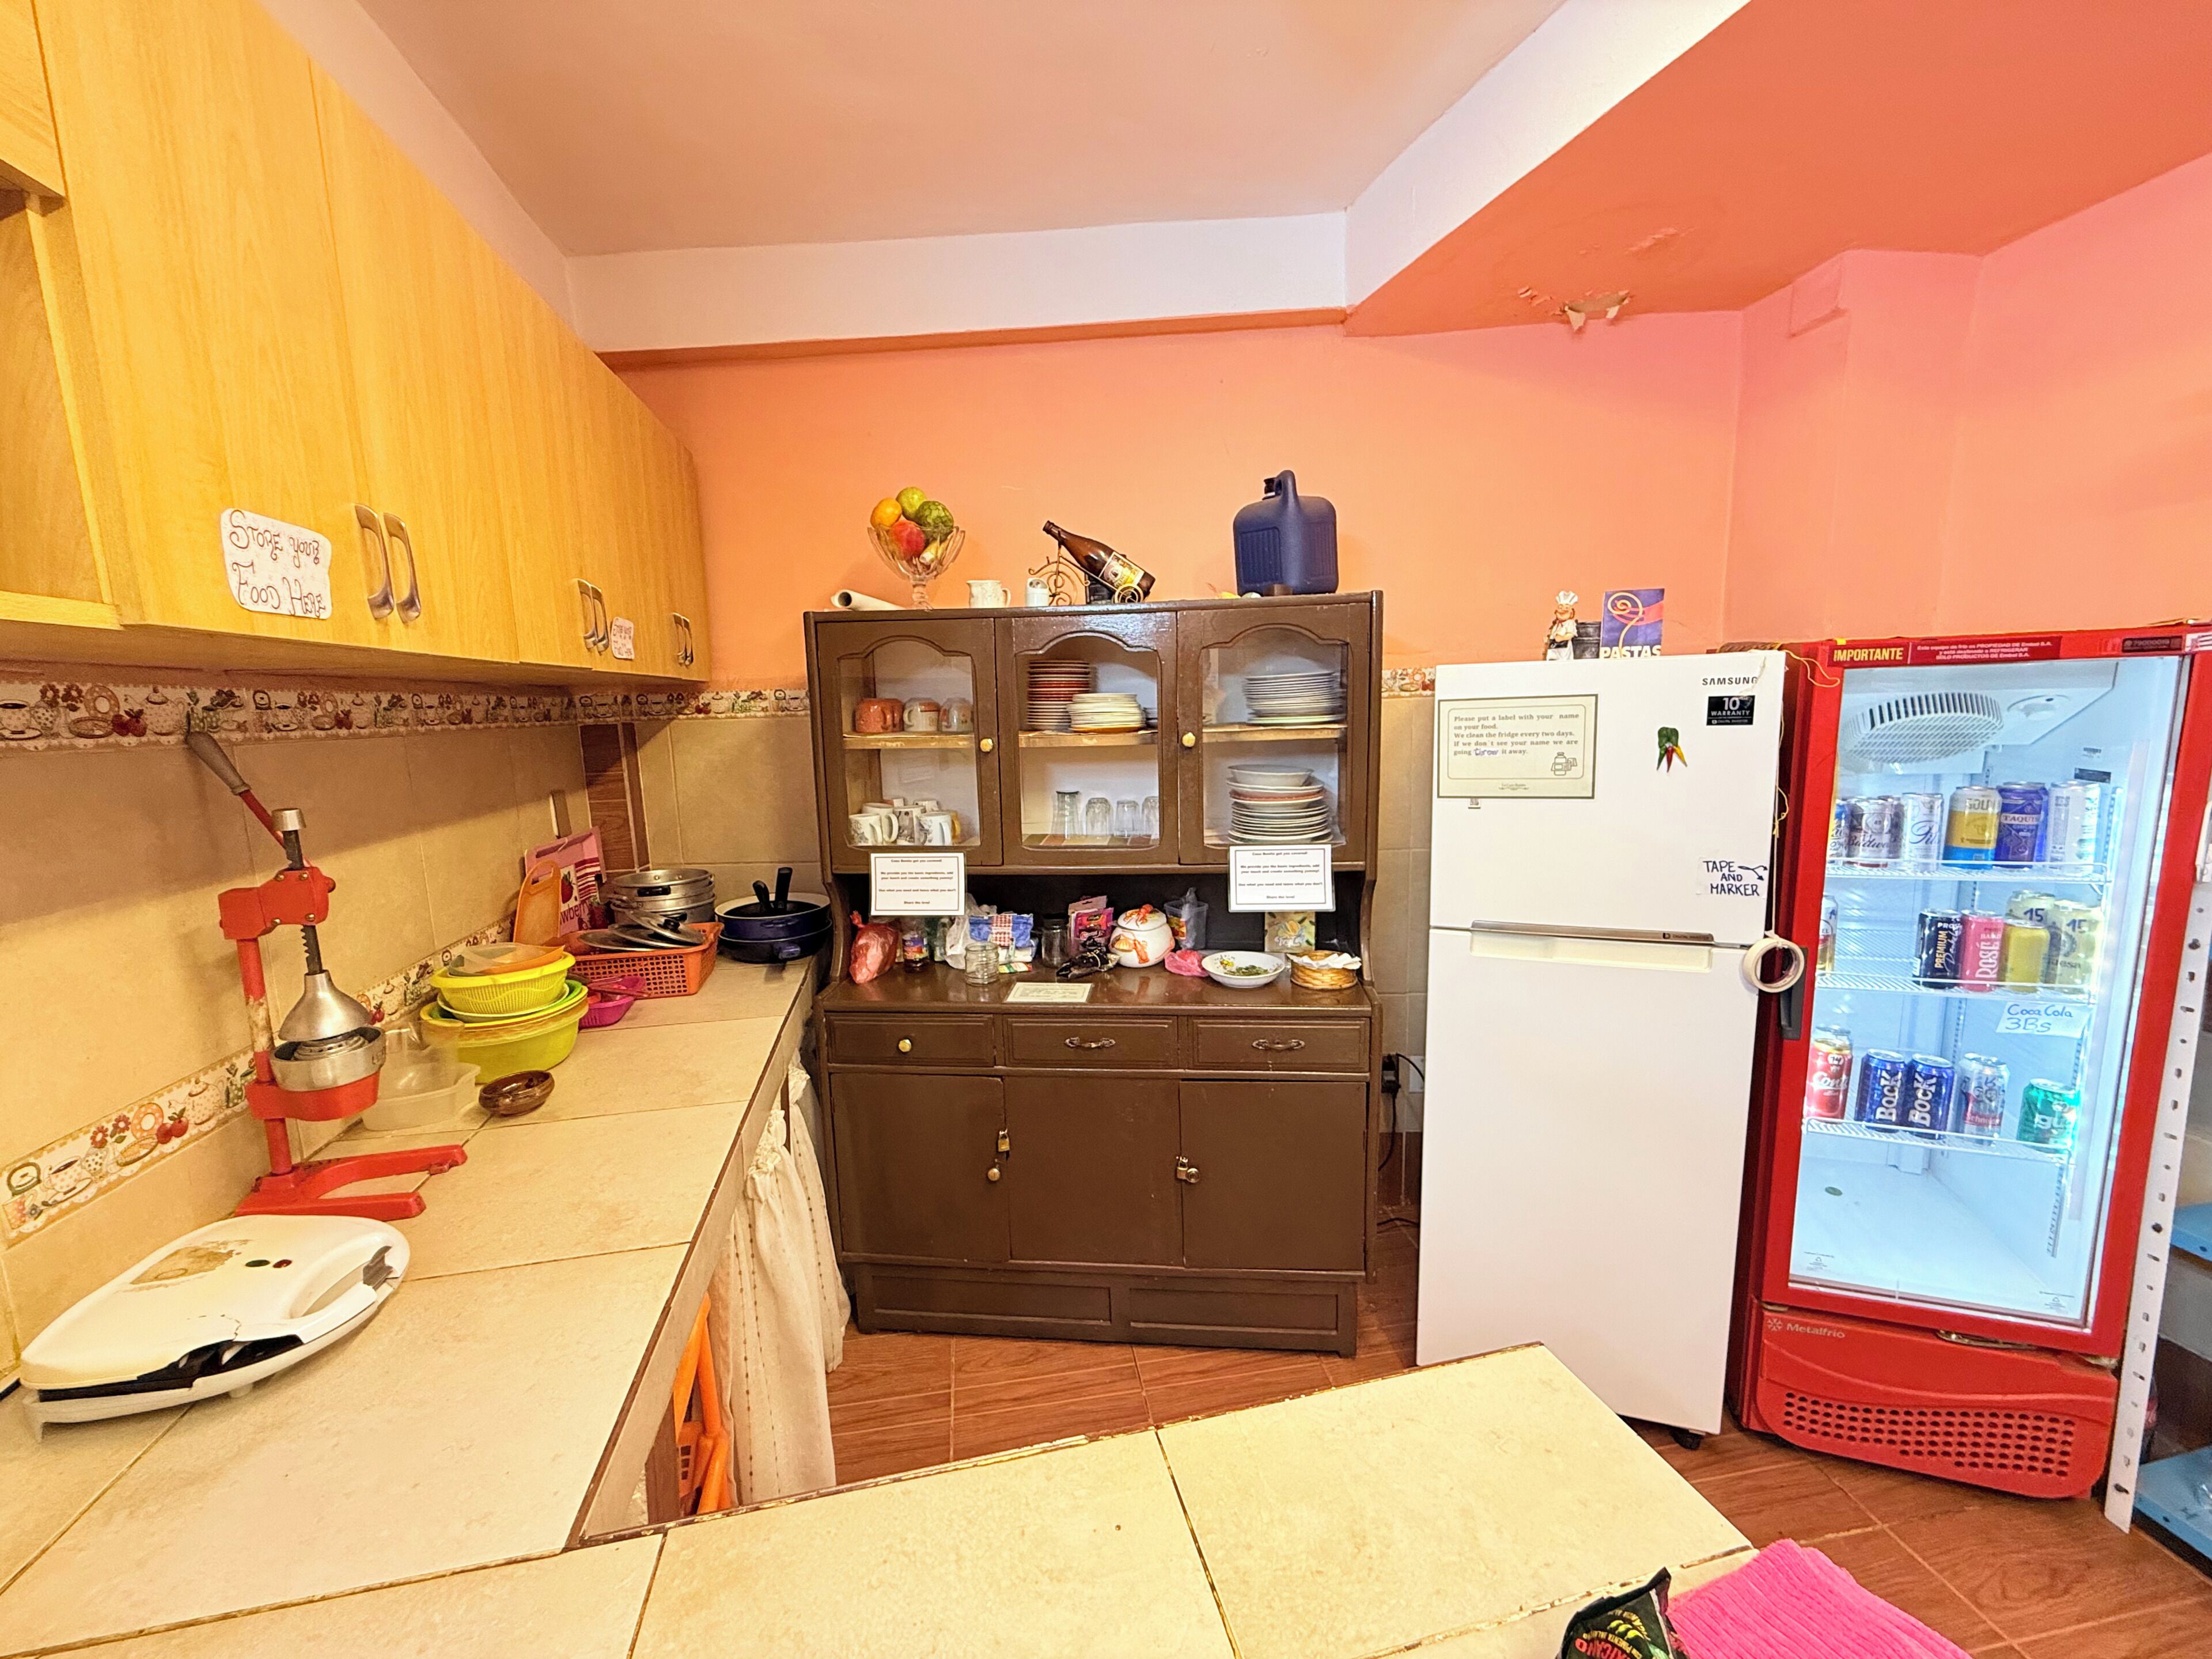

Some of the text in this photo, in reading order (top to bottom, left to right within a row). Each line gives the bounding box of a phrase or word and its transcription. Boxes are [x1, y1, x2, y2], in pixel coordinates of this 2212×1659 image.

[232, 559, 281, 609] FOOD
[1600, 645, 1661, 658] PASTAS
[1834, 647, 1903, 662] IMPORTANTE
[1702, 676, 1758, 685] SAMSUNG
[1722, 697, 1740, 710] 10
[1498, 731, 1518, 739] fridge
[1703, 861, 1736, 873] TAPE
[1721, 873, 1743, 881] AND
[1710, 883, 1760, 896] MARKER
[2023, 908, 2045, 922] 15
[1934, 930, 1948, 968] PREMIUM
[1975, 941, 2001, 979] ROSÉ
[2008, 1004, 2073, 1018] Coca Cola
[1876, 1069, 1902, 1122] BOCK
[1908, 1072, 1937, 1127] BOCK
[1786, 1323, 1845, 1339] Metalfrio
